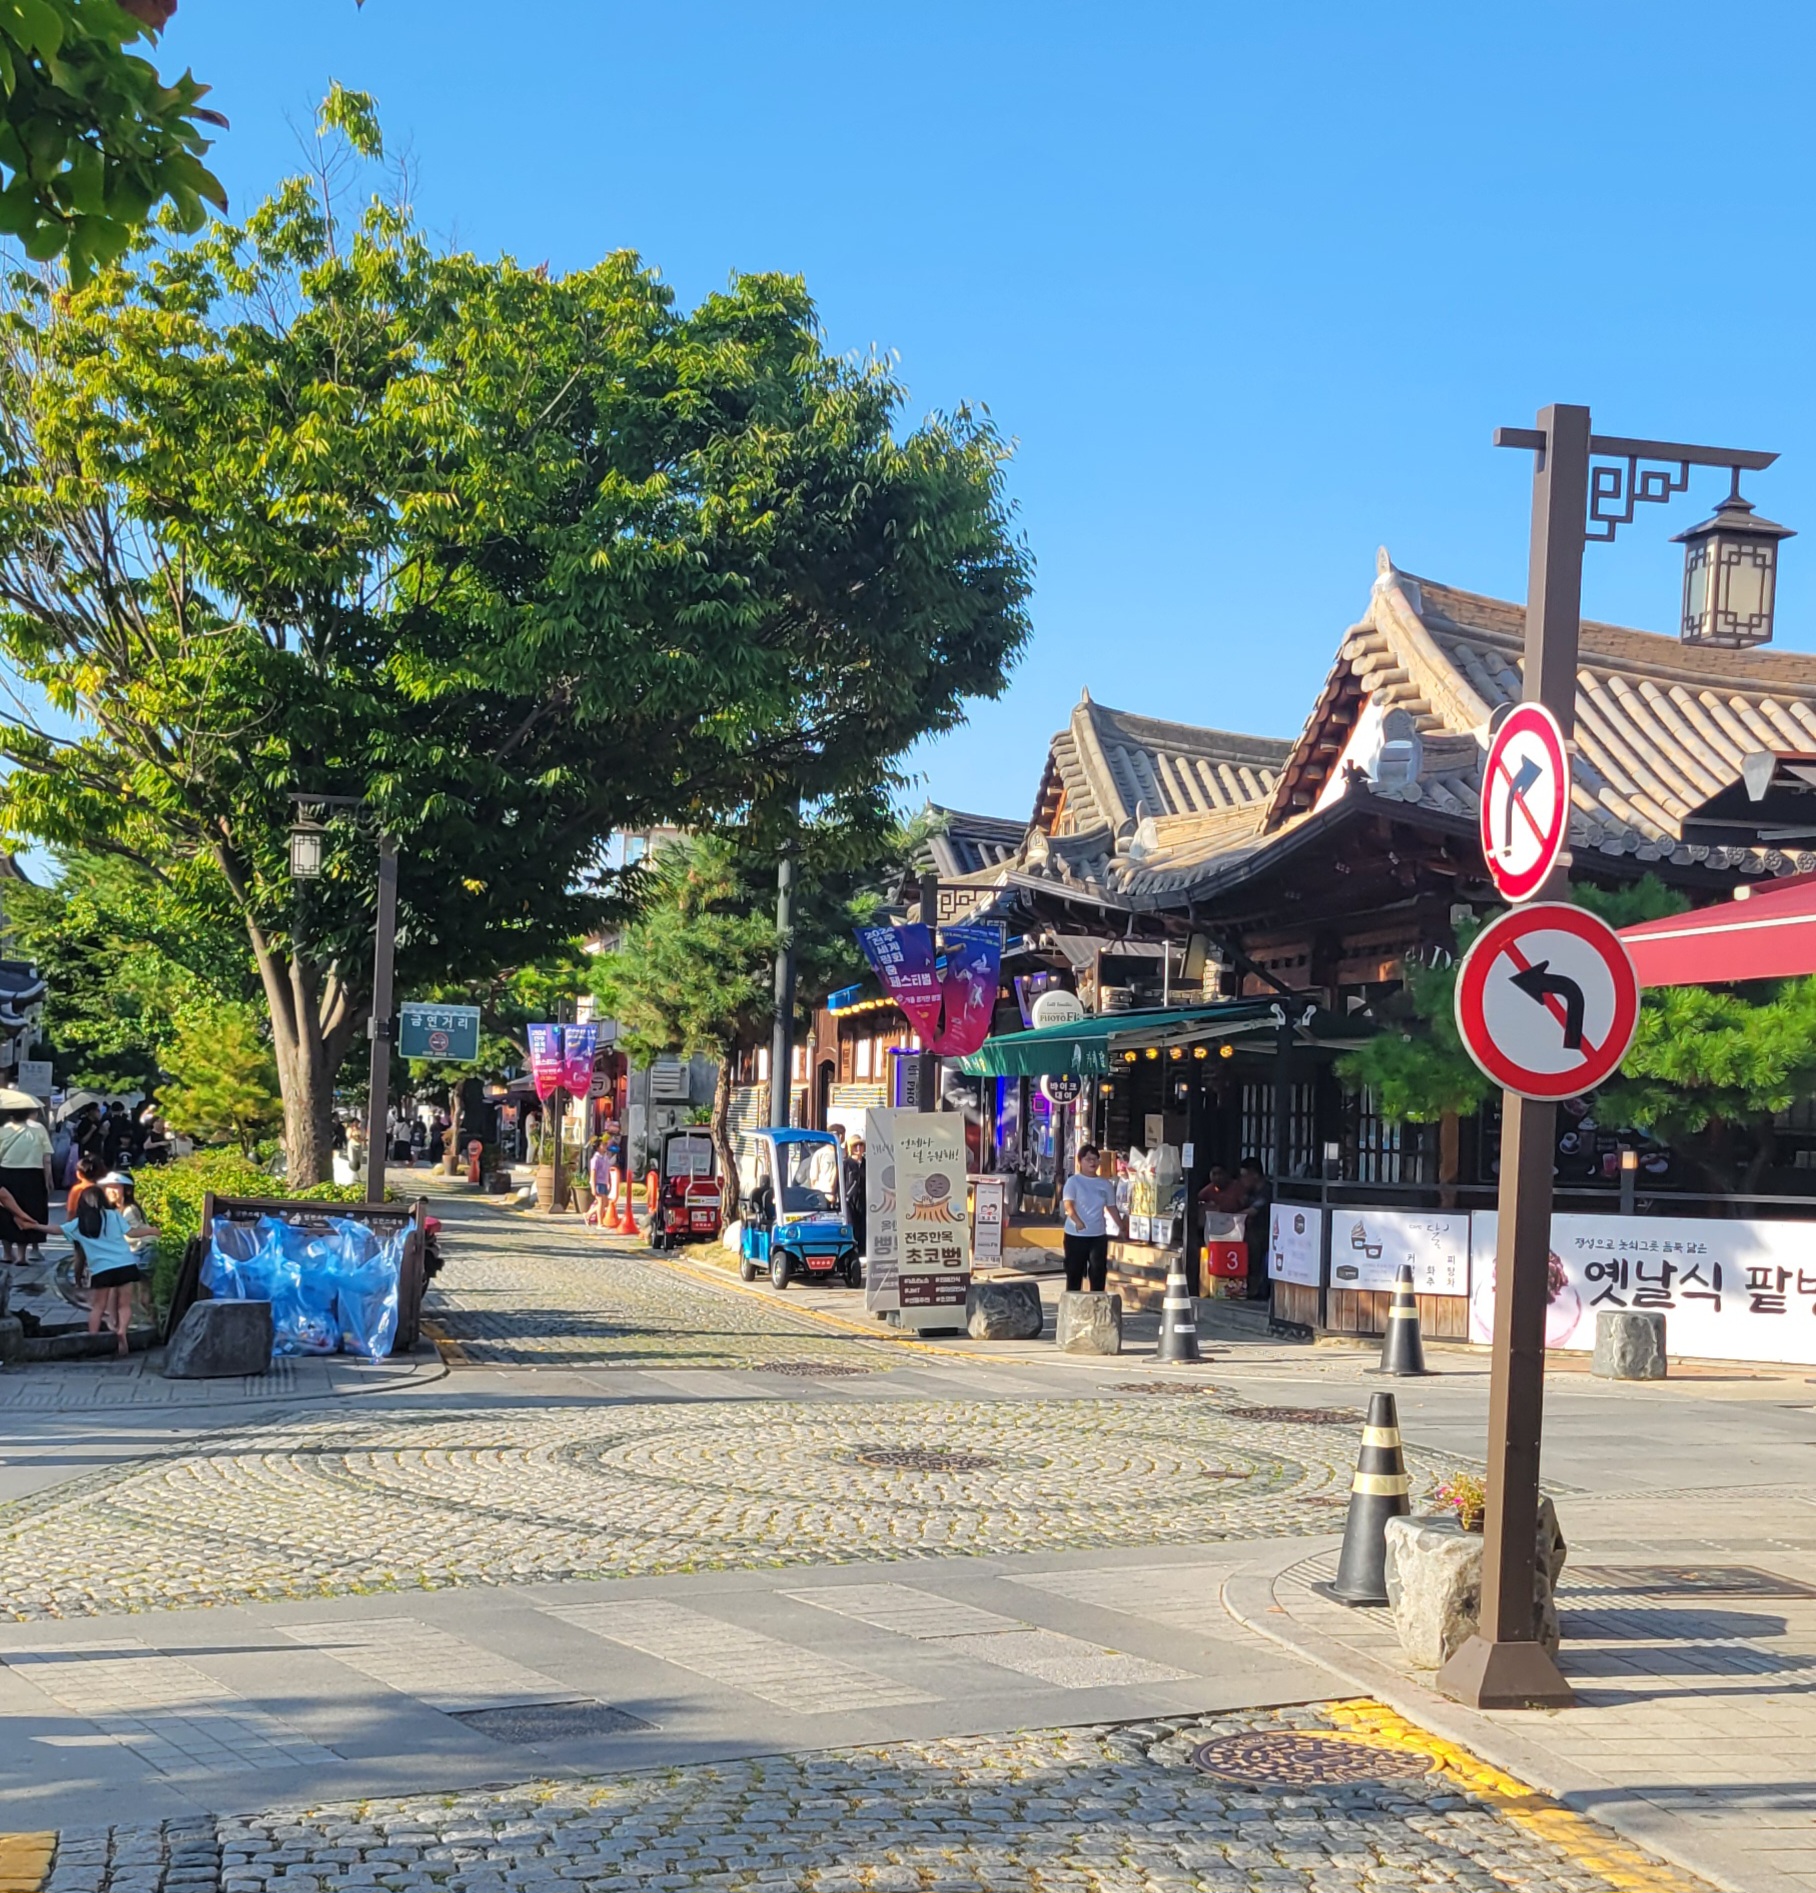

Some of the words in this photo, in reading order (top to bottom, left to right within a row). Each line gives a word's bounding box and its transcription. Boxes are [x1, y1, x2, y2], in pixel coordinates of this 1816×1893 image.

[871, 933, 895, 946] 전주
[877, 941, 900, 954] 세계
[880, 951, 904, 965] 평화
[889, 973, 932, 988] 페스티벌
[410, 1013, 468, 1030] 금연거리
[1050, 1081, 1078, 1091] 바이크
[1054, 1090, 1072, 1100] 대여
[900, 1137, 934, 1149] 언제나
[912, 1149, 924, 1164] 널
[927, 1148, 959, 1162] 응원해!
[1574, 1237, 1616, 1250] 정성으로
[1618, 1238, 1660, 1252] 놋쇠그릇
[905, 1246, 962, 1268] 초코뻥
[1226, 1250, 1239, 1270] 3
[1584, 1257, 1723, 1313] 옛날식
